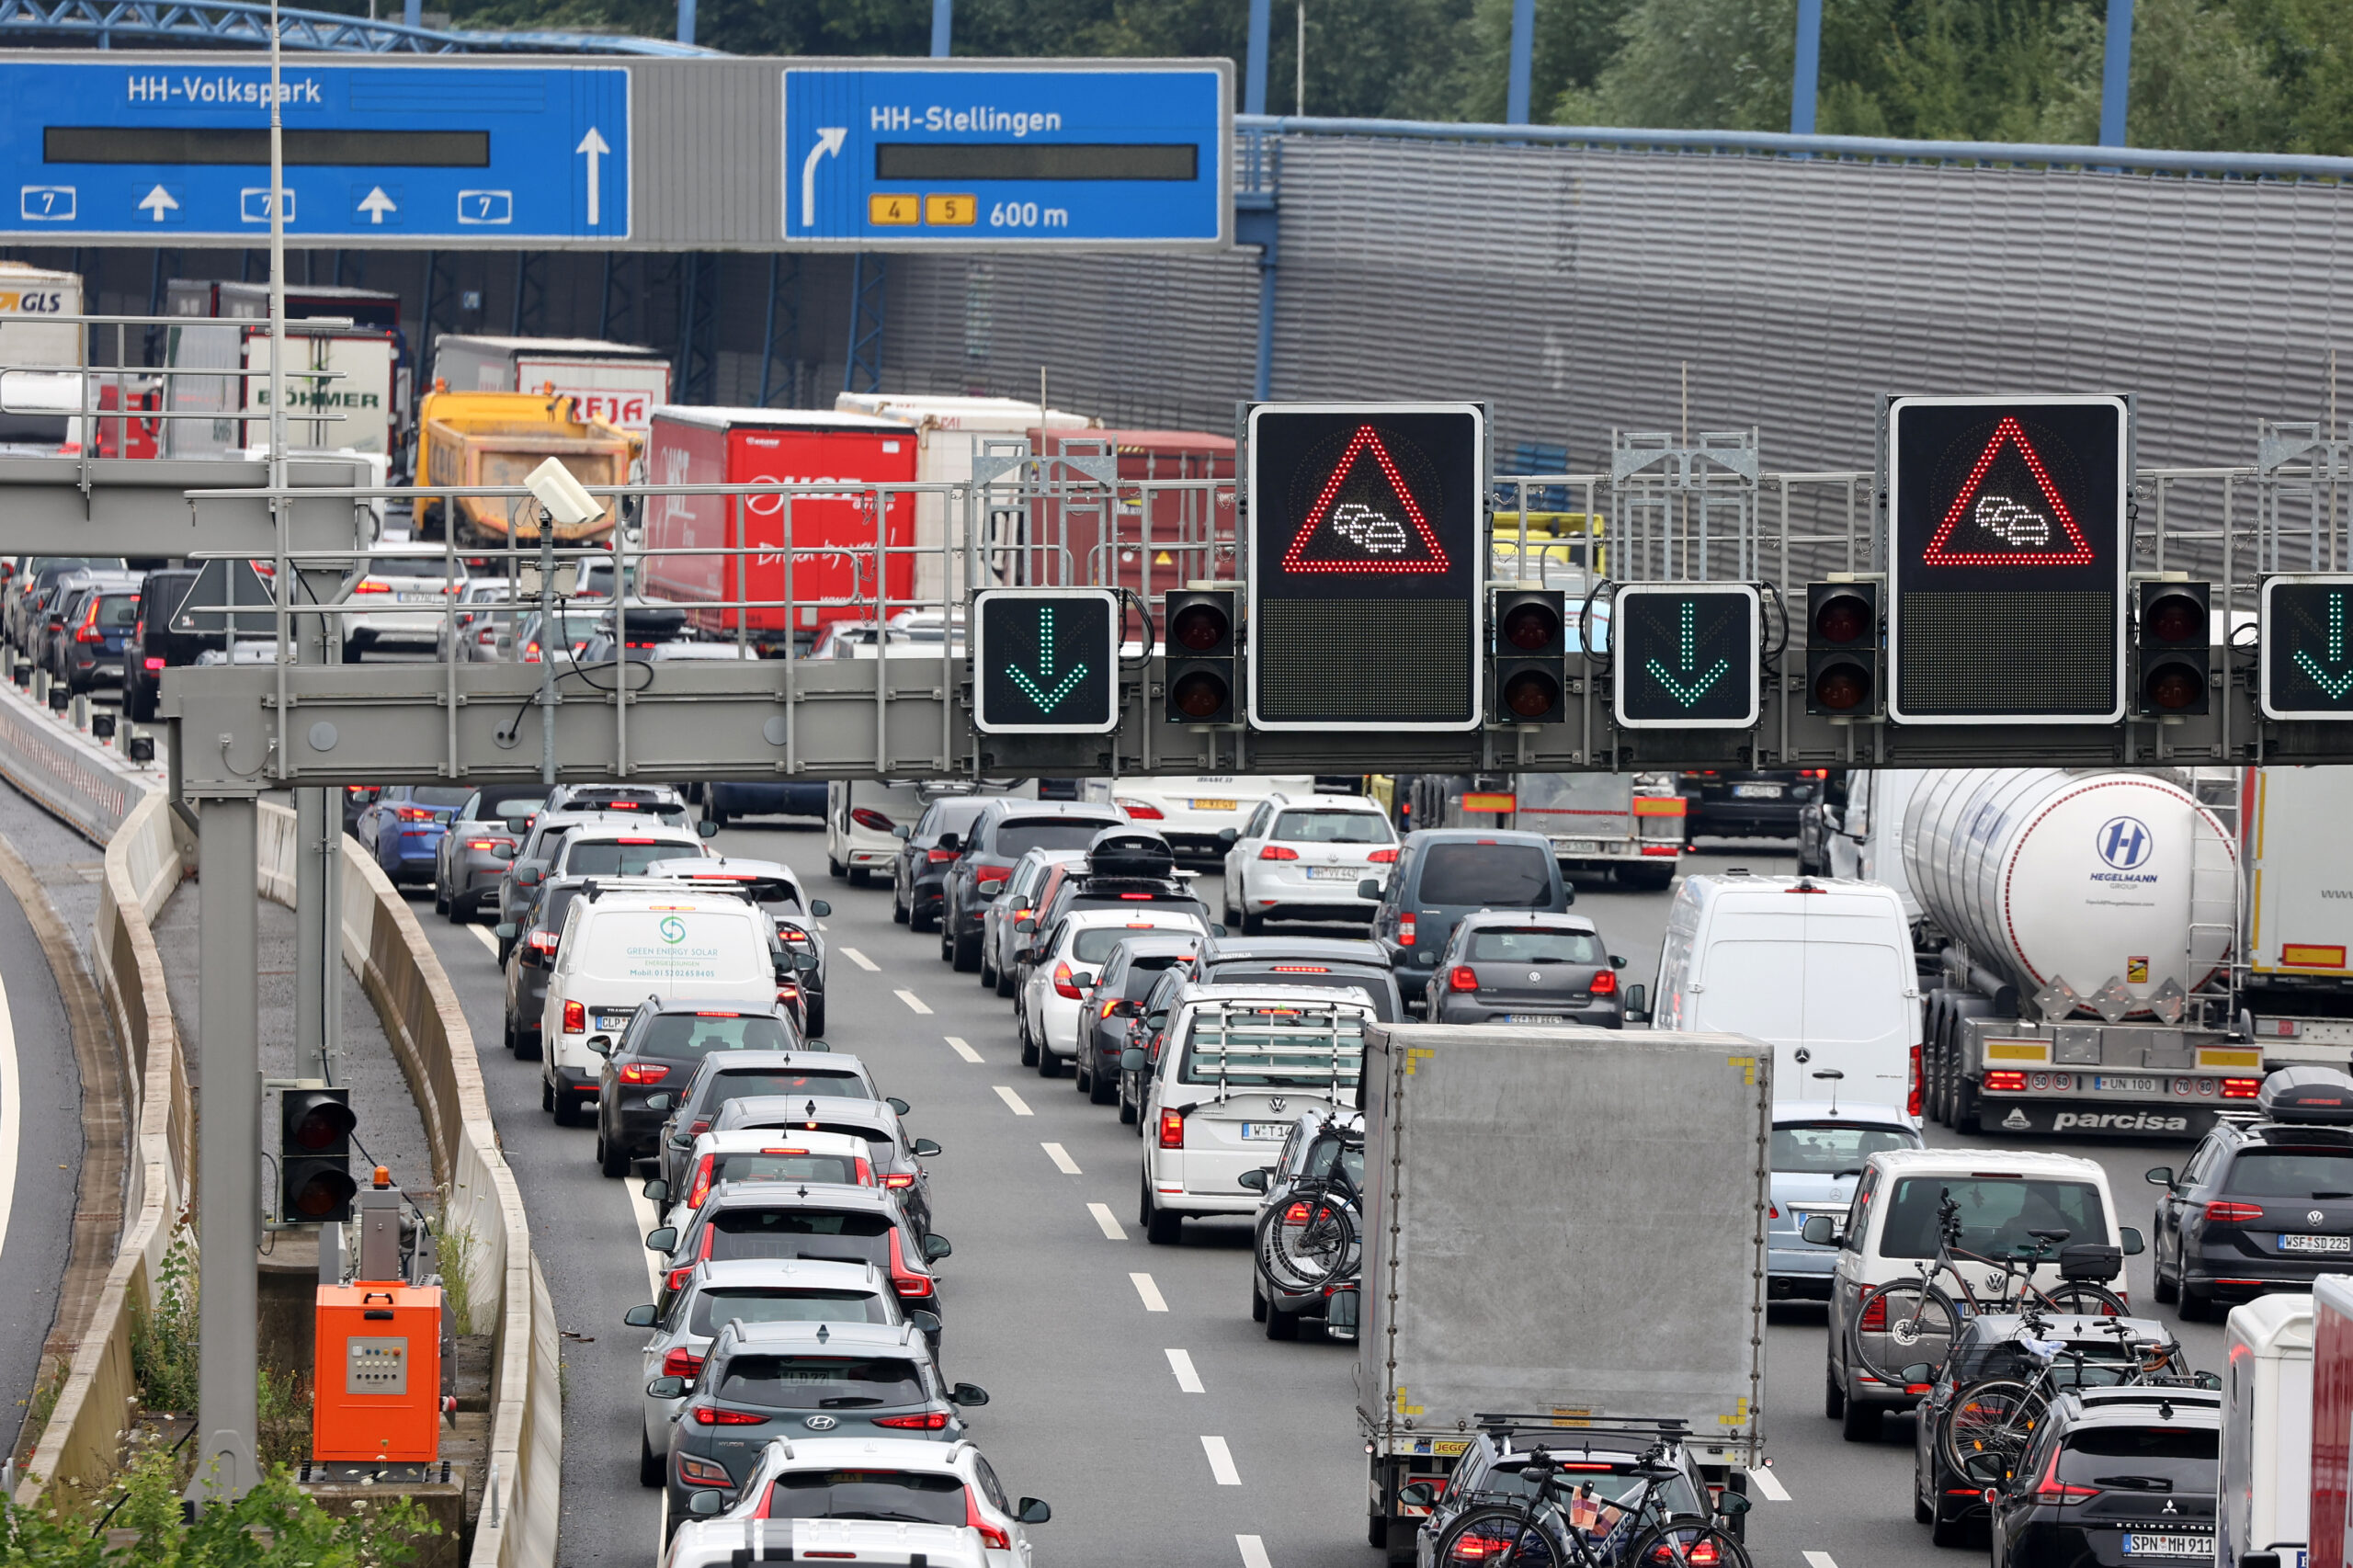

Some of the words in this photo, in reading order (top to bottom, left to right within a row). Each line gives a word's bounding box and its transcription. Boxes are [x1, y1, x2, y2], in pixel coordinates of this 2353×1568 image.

[128, 75, 322, 109] HH-Volkspark
[870, 106, 1063, 137] HH-Stellingen
[41, 192, 55, 214] 7
[261, 194, 273, 216] 7
[479, 196, 492, 218] 7
[887, 200, 901, 220] 4
[944, 200, 958, 220] 5
[989, 202, 1039, 228] 600
[1042, 208, 1068, 228] m
[21, 292, 61, 312] GLS
[2089, 872, 2158, 883] HEGELMANN
[626, 947, 654, 955] GREEN
[656, 948, 688, 956] ENERGY
[691, 948, 719, 957] SOLAR
[602, 1017, 620, 1028] CLP
[2034, 1076, 2048, 1086] 50
[2055, 1077, 2068, 1087] 60
[2110, 1078, 2127, 1090] UN
[2131, 1079, 2152, 1091] 100
[2177, 1081, 2189, 1092] 70
[2199, 1082, 2212, 1092] 80
[2052, 1110, 2188, 1131] parcisa
[2285, 1235, 2306, 1248] WSF
[2313, 1236, 2328, 1249] SD
[2329, 1237, 2349, 1250] 225
[1435, 1443, 1467, 1452] JEGG
[1598, 1510, 1635, 1558] STEVEN
[2131, 1535, 2158, 1551] SPN
[2167, 1537, 2186, 1552] MH
[2188, 1538, 2213, 1553] 911
